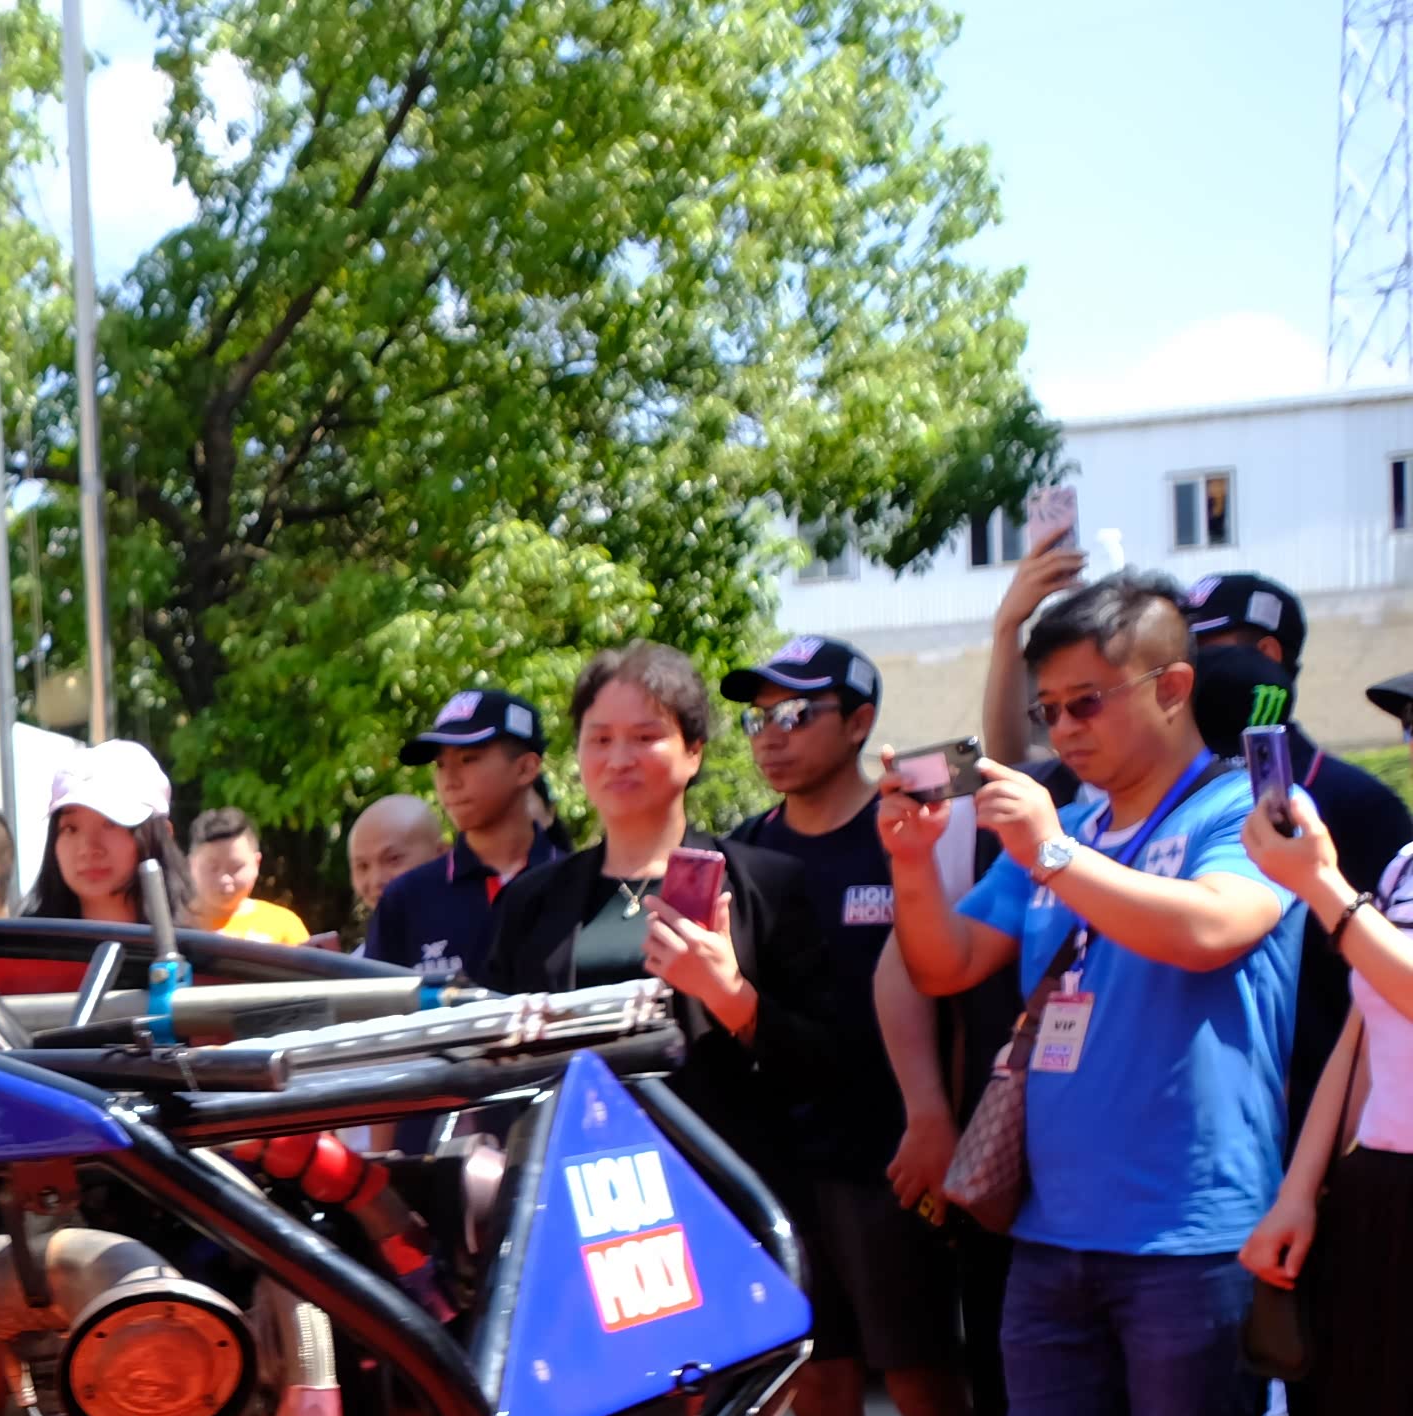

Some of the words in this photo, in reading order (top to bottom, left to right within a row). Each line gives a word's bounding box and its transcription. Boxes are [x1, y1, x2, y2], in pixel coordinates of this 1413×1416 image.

[850, 887, 893, 902] LIQU
[564, 1150, 675, 1239] LIQUI
[585, 1230, 693, 1326] MOLY
